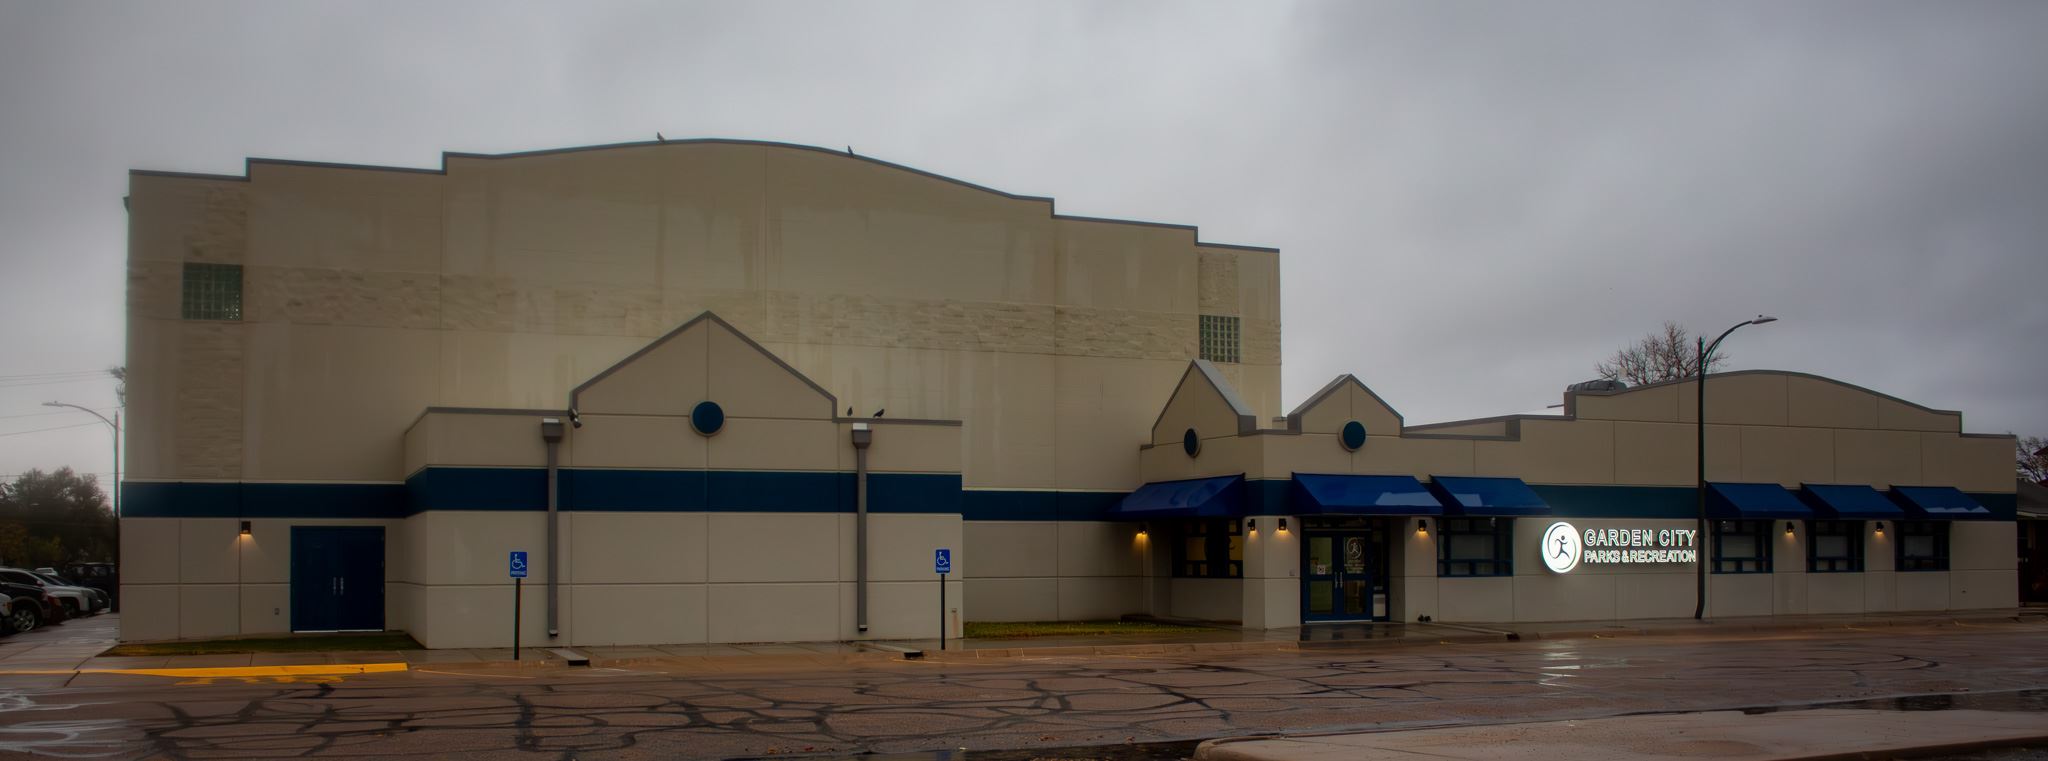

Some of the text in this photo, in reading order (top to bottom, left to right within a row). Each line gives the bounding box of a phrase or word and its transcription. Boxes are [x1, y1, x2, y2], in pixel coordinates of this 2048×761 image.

[1584, 529, 1696, 547] GARDEN CITY
[1584, 550, 1620, 563] PARKS
[1630, 550, 1696, 563] RECREATION
